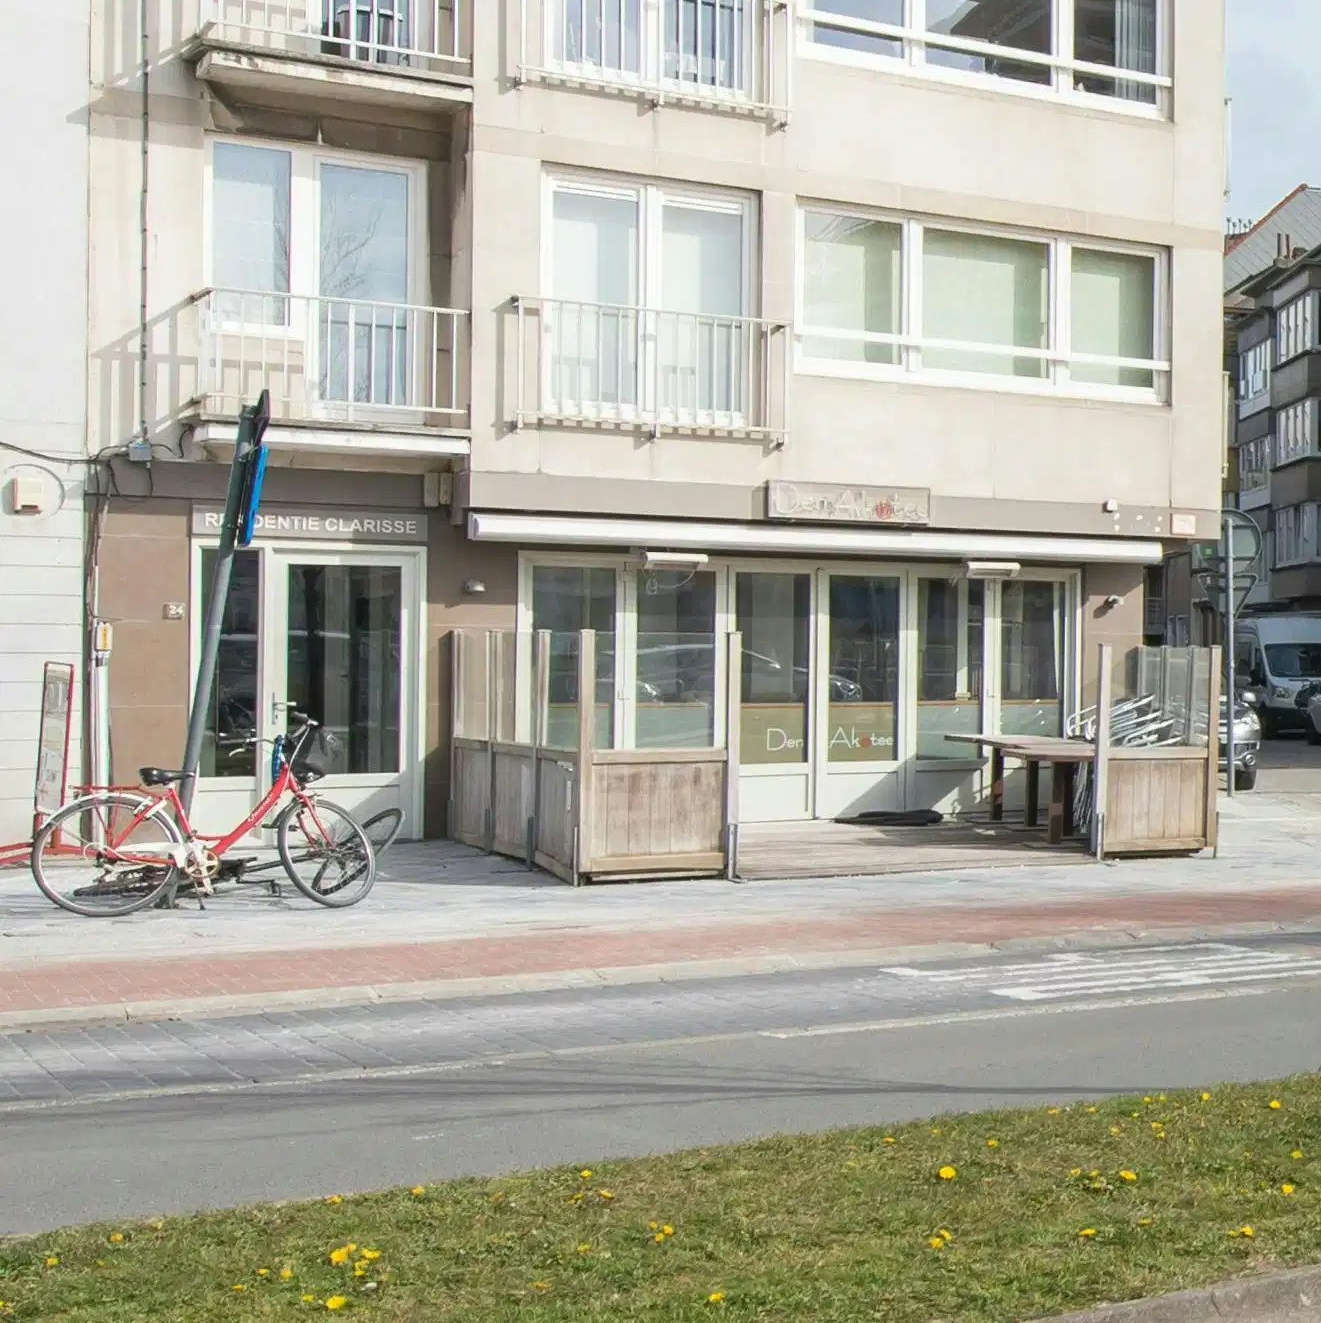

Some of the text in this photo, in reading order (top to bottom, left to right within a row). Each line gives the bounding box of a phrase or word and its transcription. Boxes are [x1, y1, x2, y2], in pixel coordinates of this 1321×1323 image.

[776, 482, 828, 514] Den
[205, 513, 417, 534] RDENTIE CLARISSE
[168, 605, 183, 615] 24
[766, 727, 804, 751] Den
